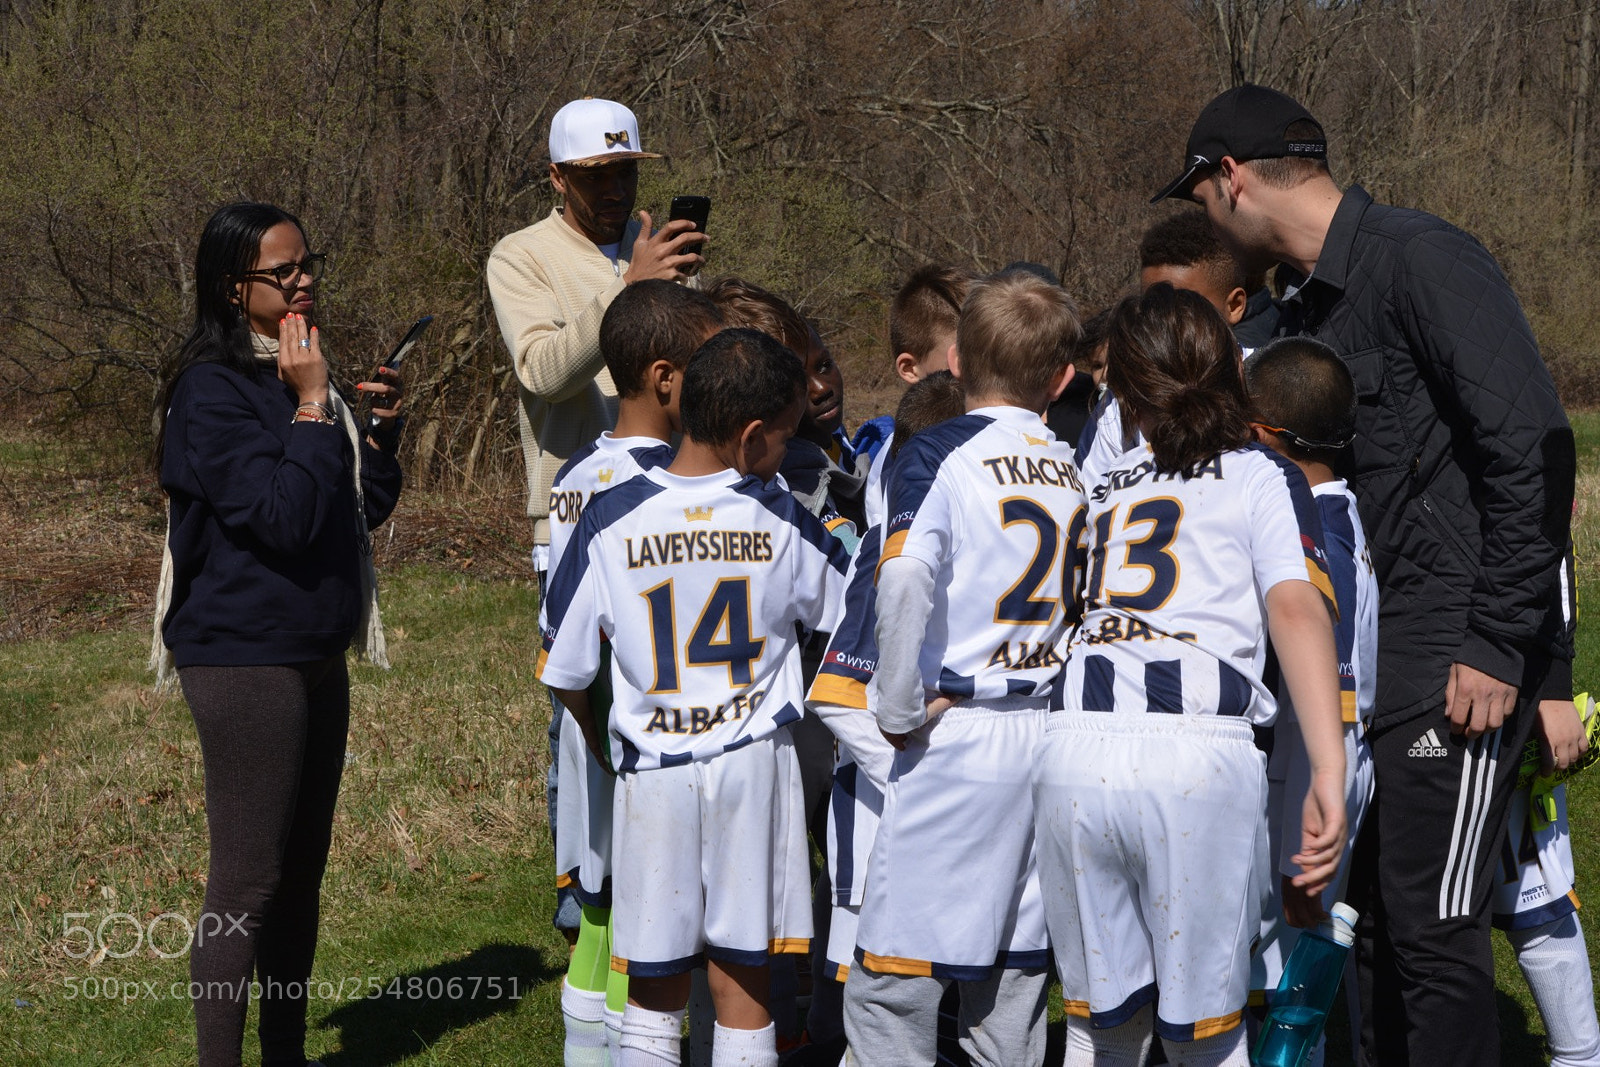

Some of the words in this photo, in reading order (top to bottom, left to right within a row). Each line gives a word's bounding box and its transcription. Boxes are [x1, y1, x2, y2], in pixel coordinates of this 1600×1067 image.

[549, 490, 594, 523] PORR
[624, 530, 773, 570] LAVEYSSIERES
[1082, 495, 1184, 613] 13
[638, 575, 766, 694] 14
[643, 704, 727, 735] ALBA
[1407, 746, 1448, 758] adidas
